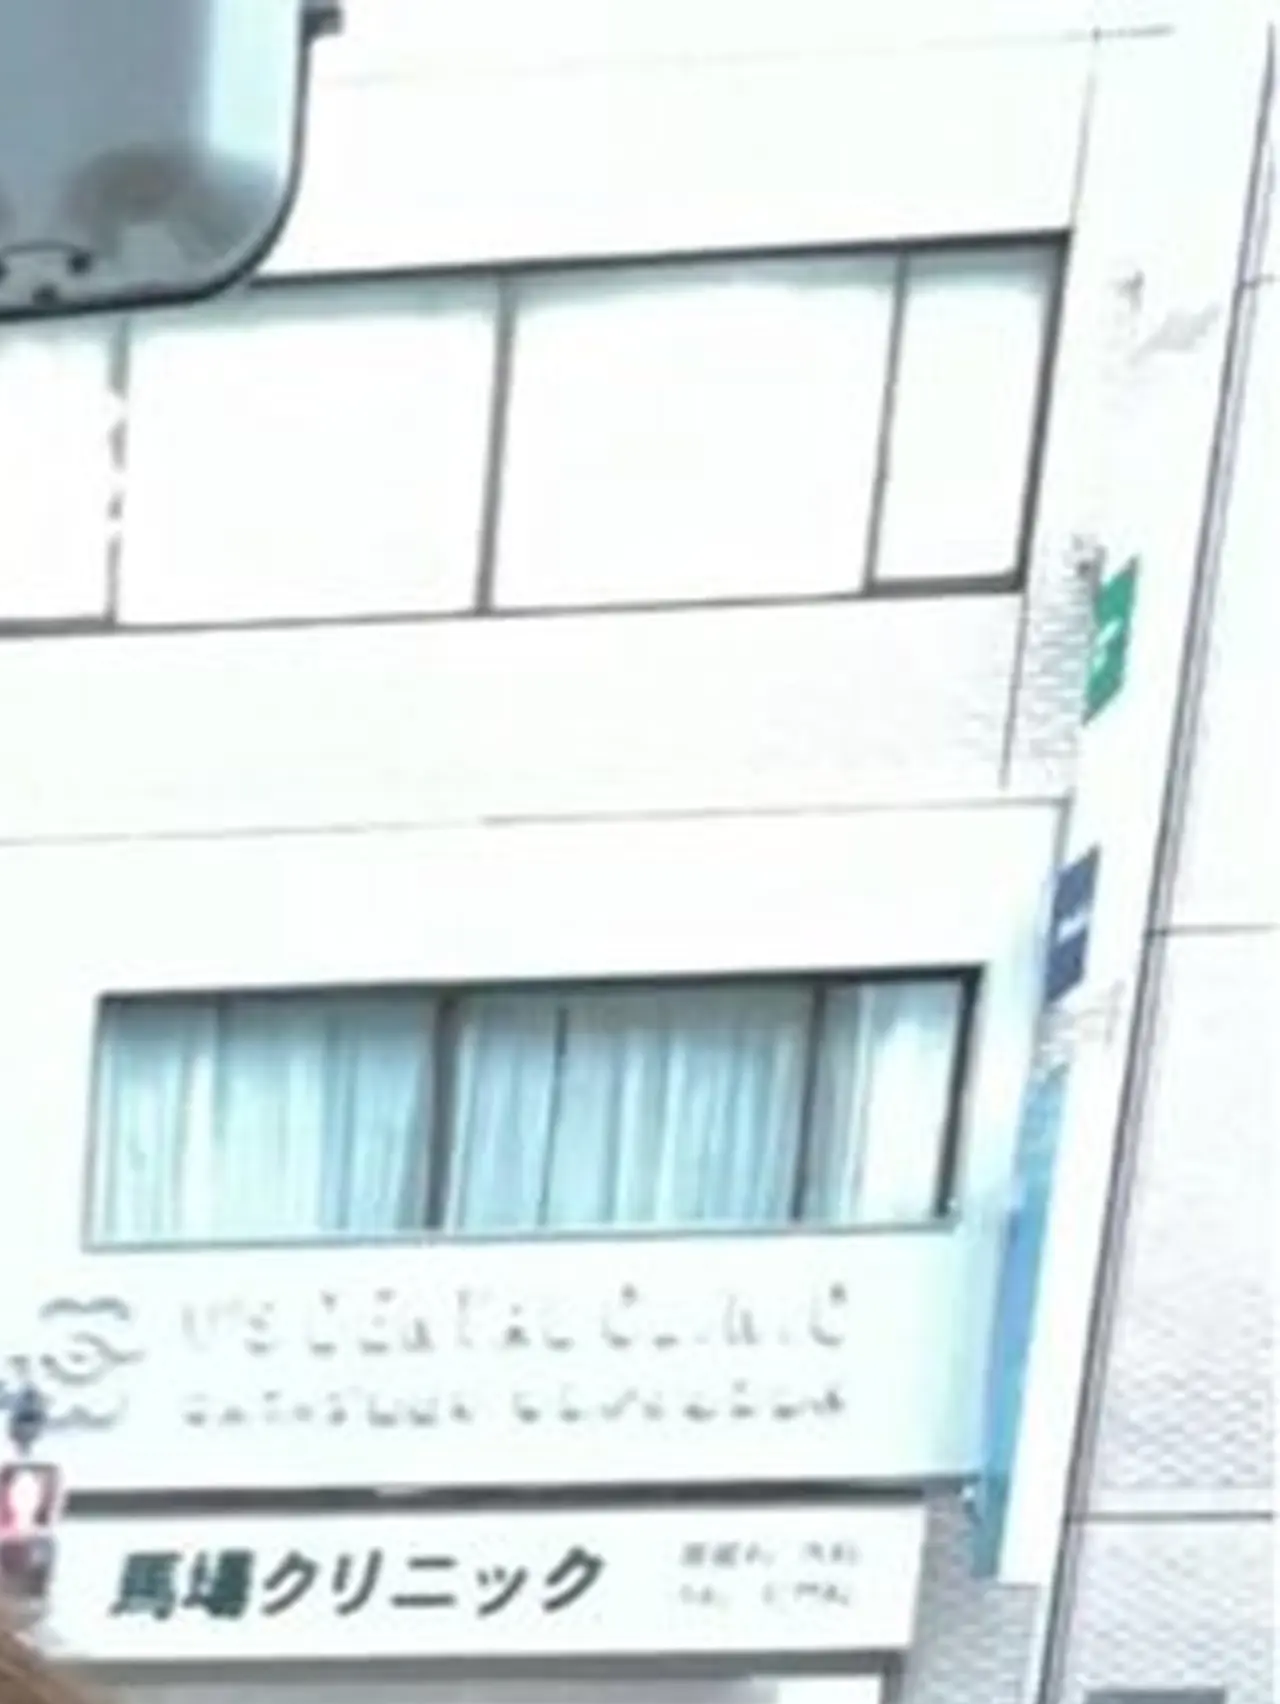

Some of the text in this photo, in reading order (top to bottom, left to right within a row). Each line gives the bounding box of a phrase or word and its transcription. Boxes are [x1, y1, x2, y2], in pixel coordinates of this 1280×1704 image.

[108, 1545, 606, 1620] 馬場クリニック
